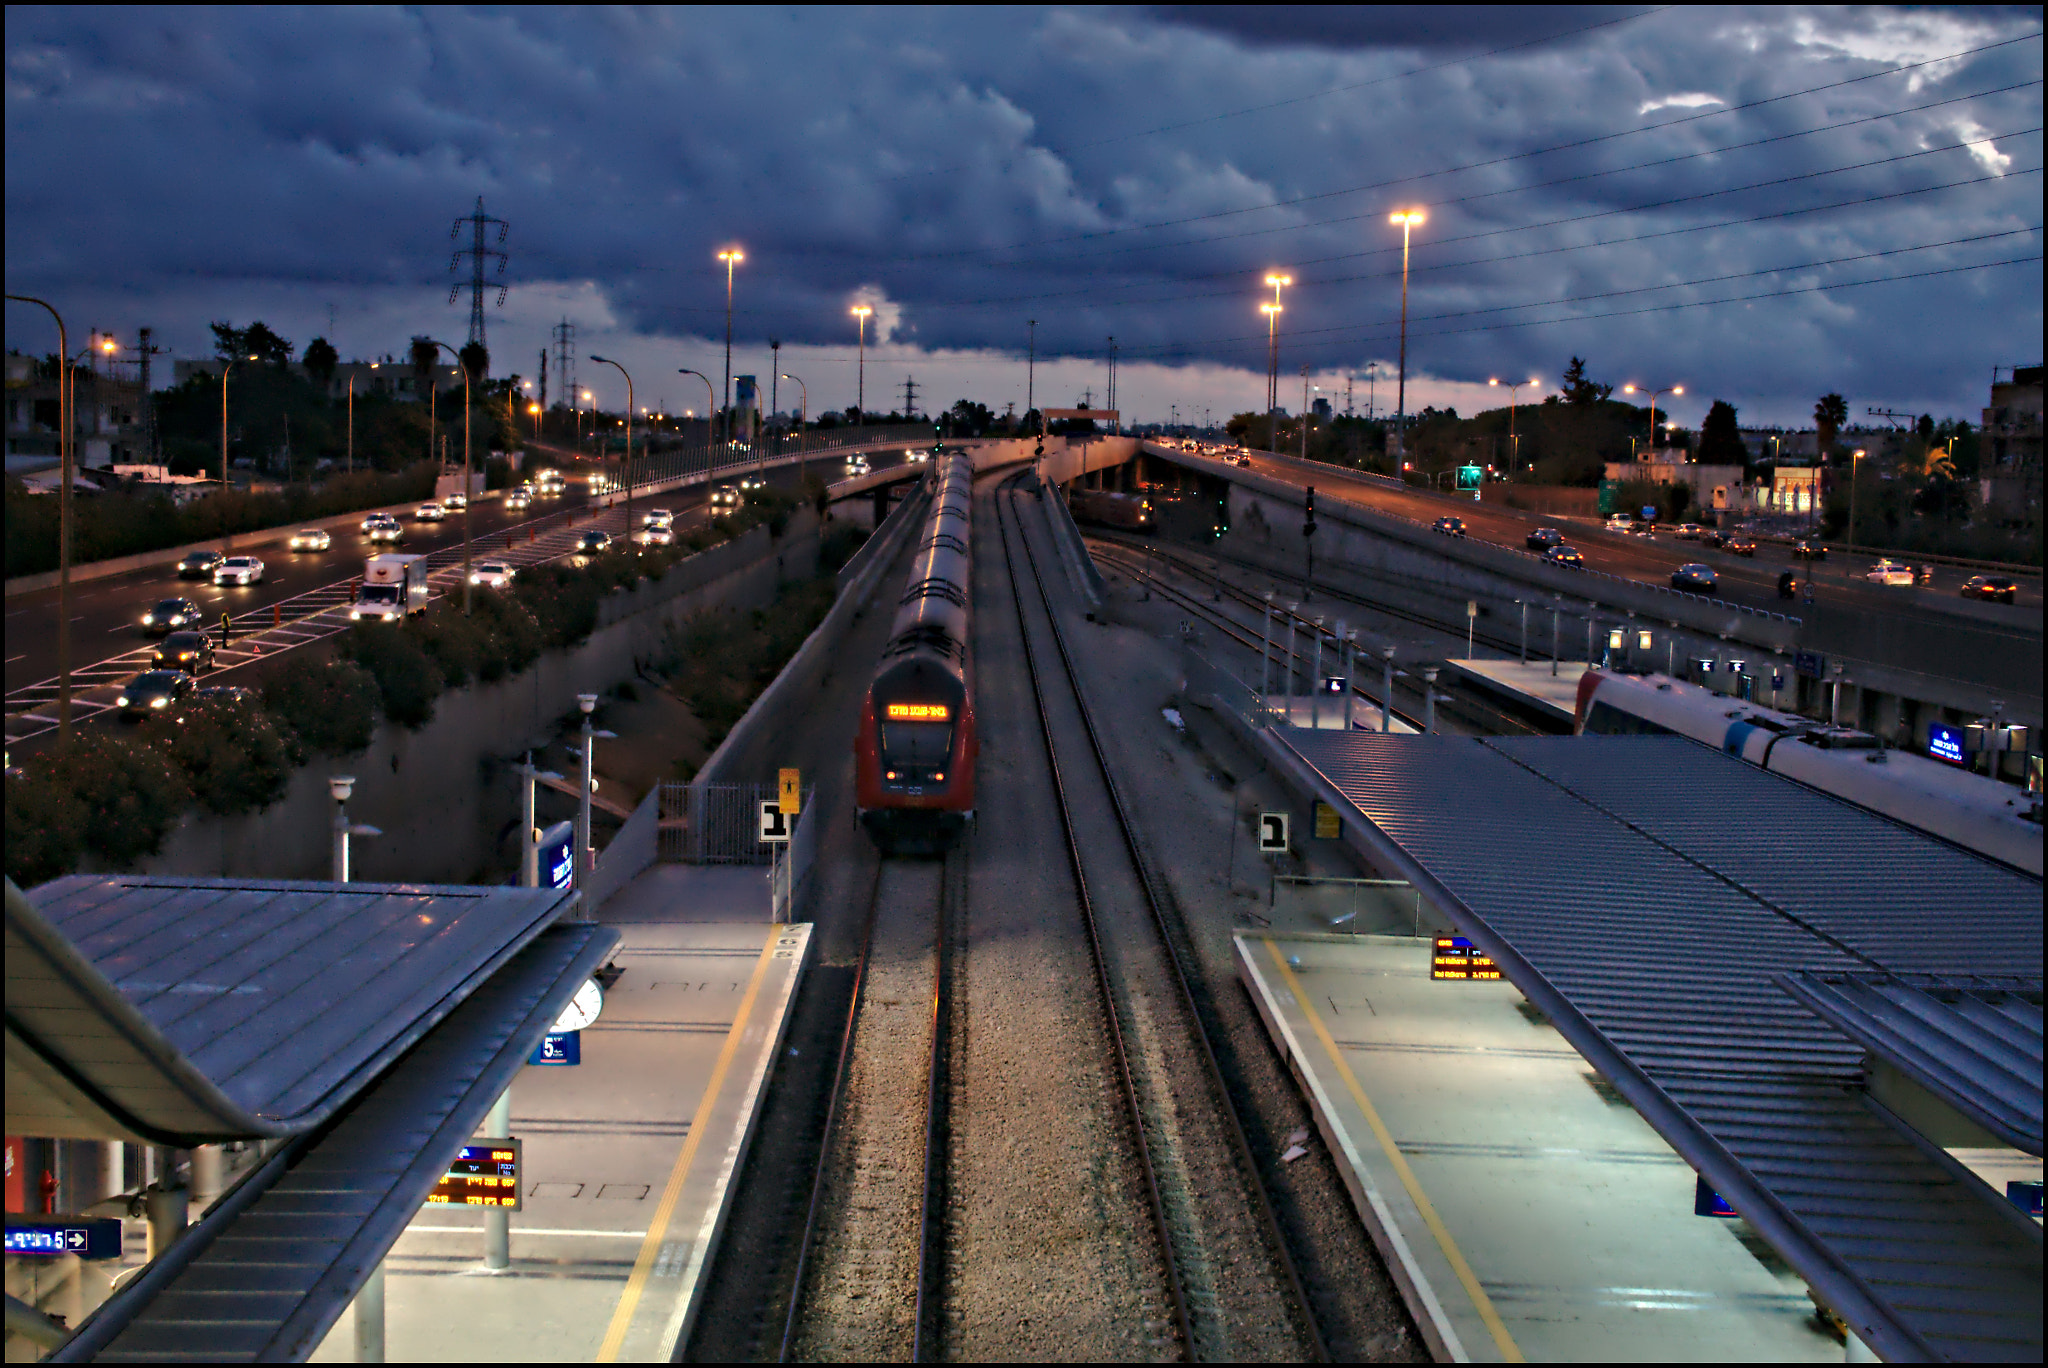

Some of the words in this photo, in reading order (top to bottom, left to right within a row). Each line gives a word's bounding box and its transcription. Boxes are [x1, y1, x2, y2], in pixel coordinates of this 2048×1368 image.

[1263, 816, 1285, 848] ב
[544, 1036, 554, 1057] 5
[55, 1231, 64, 1249] 5
